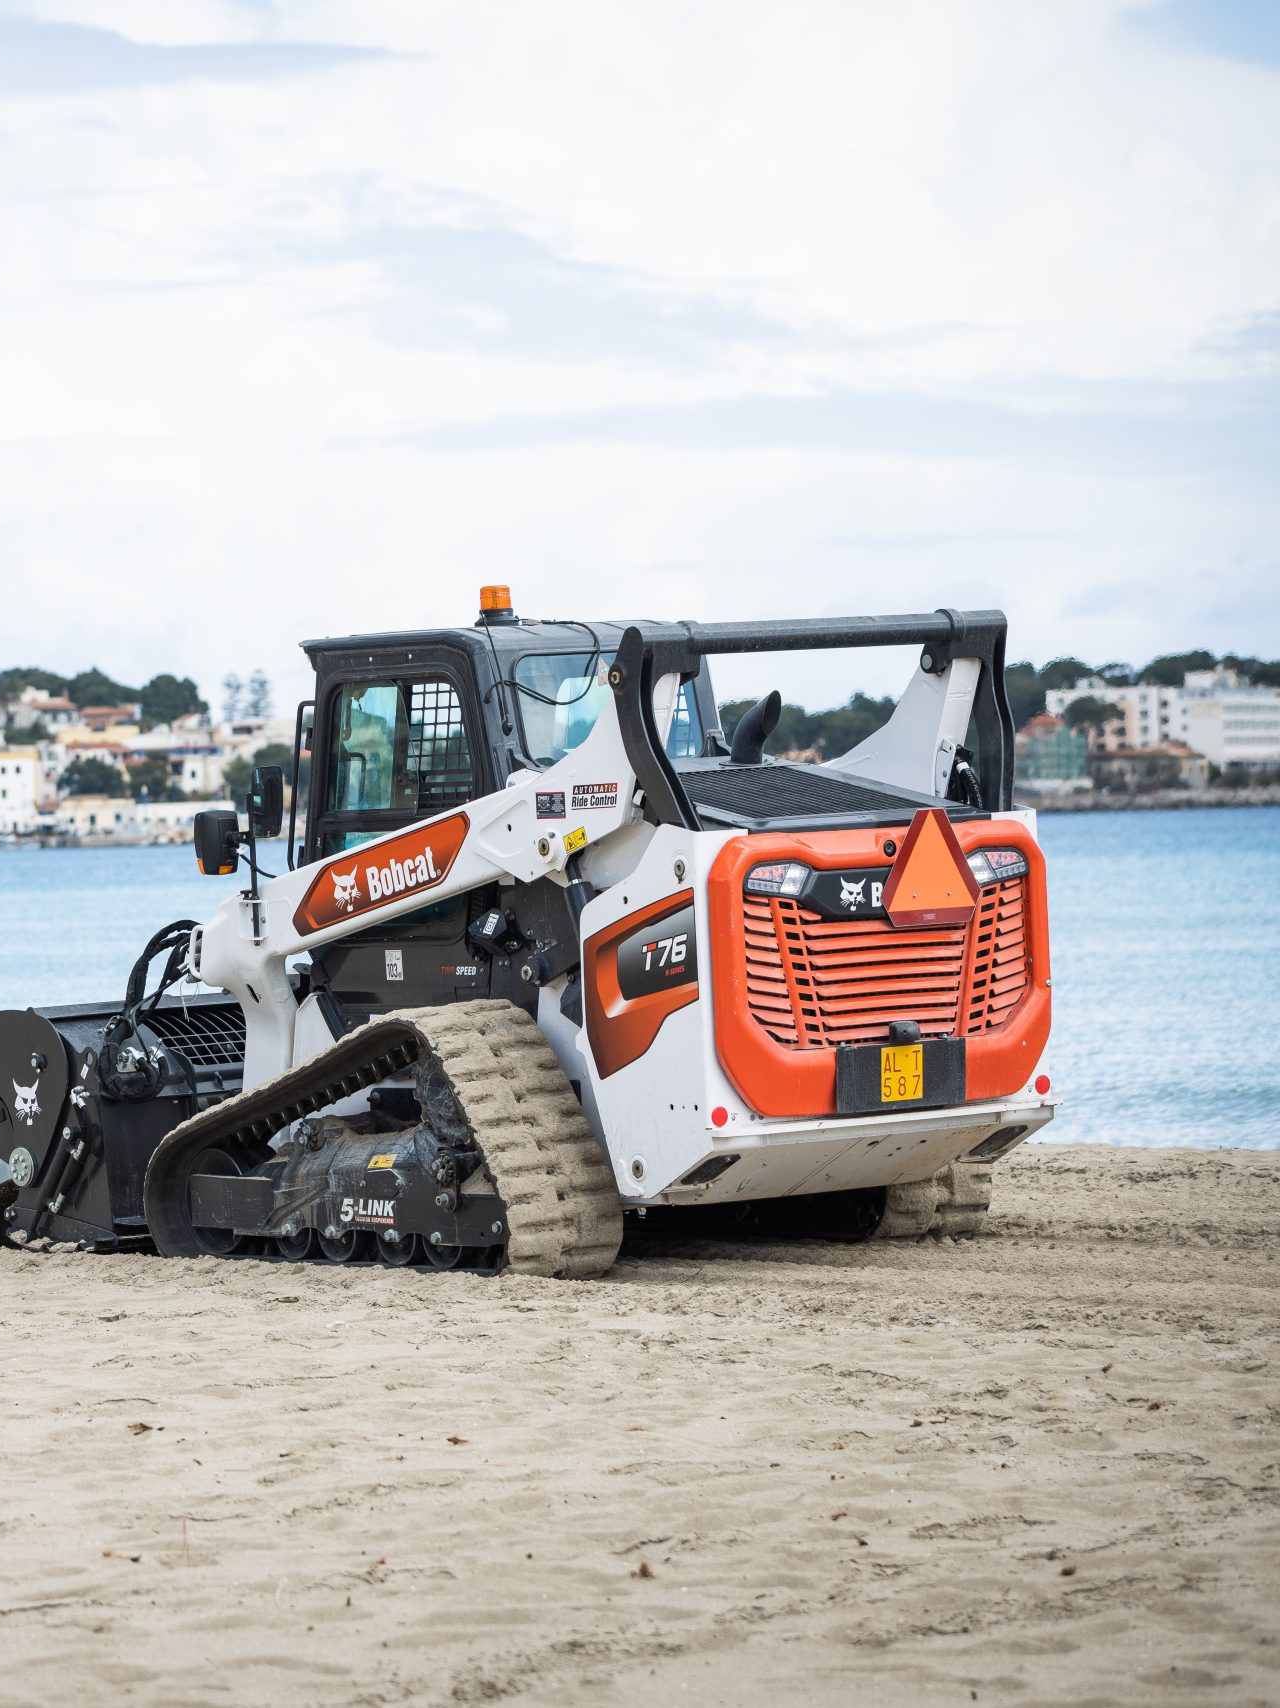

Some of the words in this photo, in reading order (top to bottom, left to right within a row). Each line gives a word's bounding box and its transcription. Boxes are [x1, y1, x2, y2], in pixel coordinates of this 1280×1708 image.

[571, 795, 588, 807] Ride
[590, 794, 617, 807] Control
[574, 784, 616, 794] AUTOMATIC
[365, 845, 438, 902] Bobcat
[642, 933, 688, 971] T76
[387, 963, 398, 978] 103
[455, 966, 477, 976] SPEED
[883, 1052, 902, 1073] AL
[913, 1050, 921, 1071] T
[883, 1075, 921, 1098] 587
[340, 1198, 395, 1222] 5-LINK
